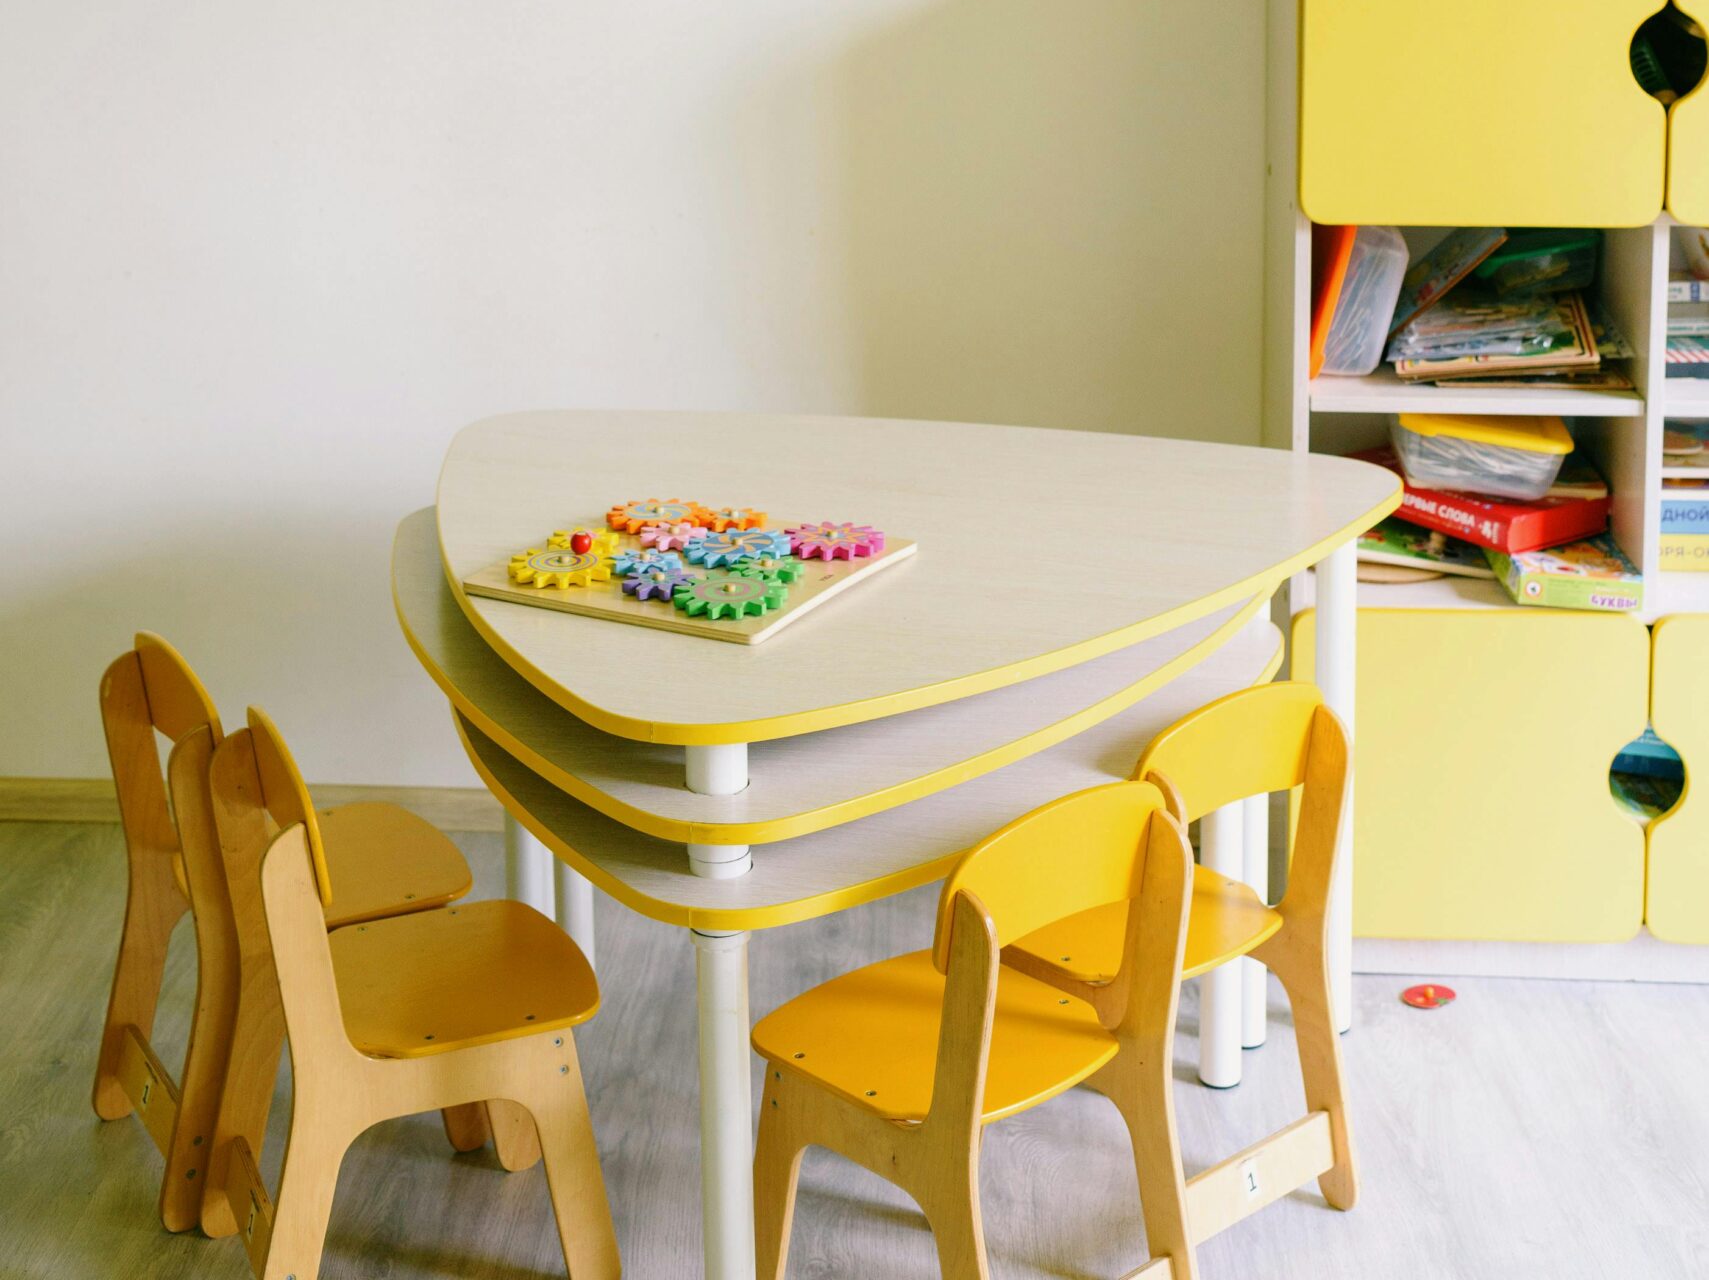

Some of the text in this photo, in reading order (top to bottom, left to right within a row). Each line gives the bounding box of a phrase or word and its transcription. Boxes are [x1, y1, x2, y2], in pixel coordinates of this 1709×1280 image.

[1437, 505, 1475, 527] СЛОВА
[1590, 594, 1638, 609] БУКВЫ
[1247, 1172, 1257, 1192] 1
